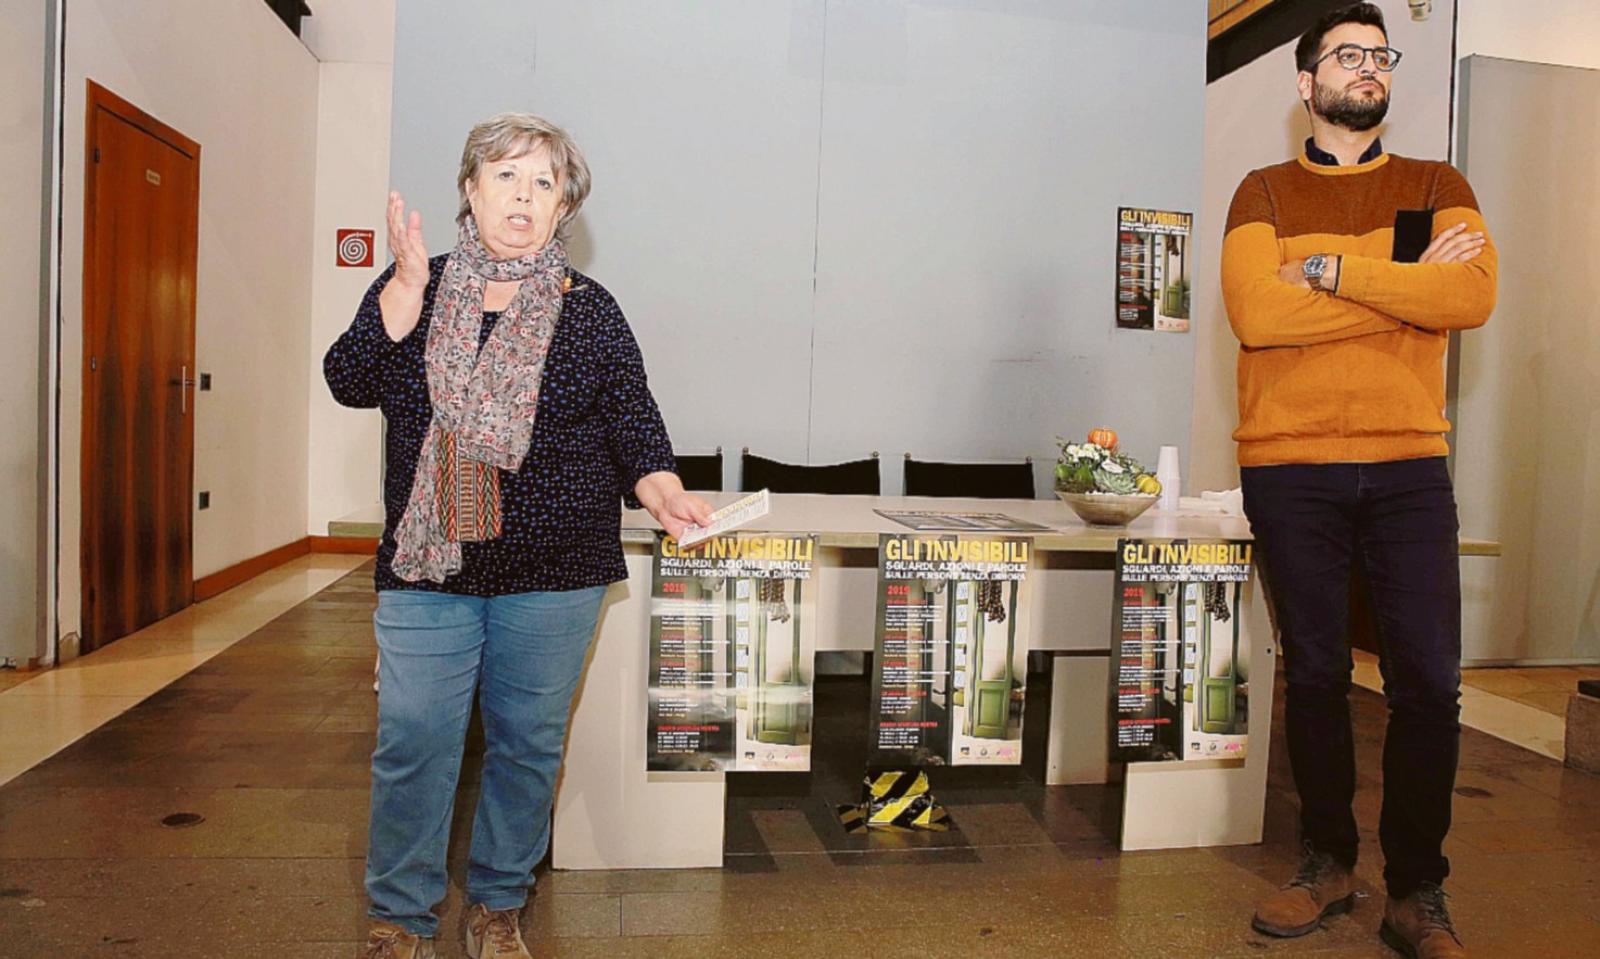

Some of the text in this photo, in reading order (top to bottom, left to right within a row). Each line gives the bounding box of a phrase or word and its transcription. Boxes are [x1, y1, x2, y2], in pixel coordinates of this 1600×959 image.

[1120, 209, 1191, 226] GLI INVISIBILI
[703, 536, 812, 562] INVISIBILI
[886, 539, 1028, 563] GLI INVISIBILI
[1123, 544, 1251, 565] GLI INVISIBILI
[769, 560, 812, 571] PAROLE
[988, 562, 1027, 573] PAROLE
[1215, 565, 1250, 574] PAROLE
